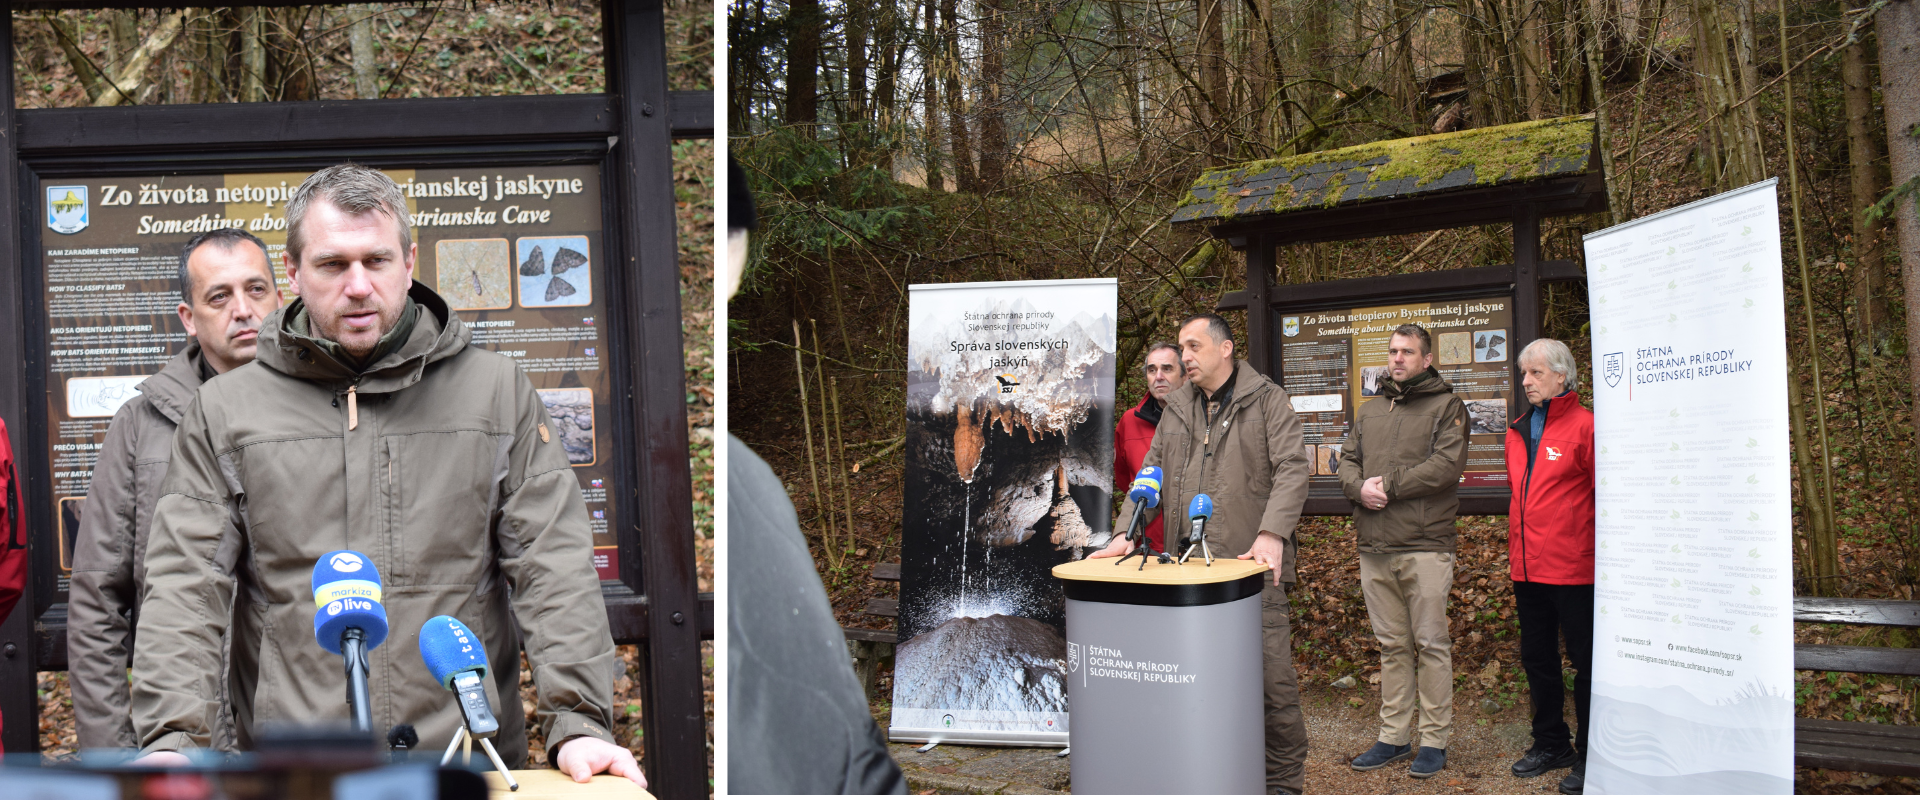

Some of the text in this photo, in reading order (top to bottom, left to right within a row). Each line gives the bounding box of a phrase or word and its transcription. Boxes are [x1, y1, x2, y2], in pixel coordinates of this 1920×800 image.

[100, 174, 583, 208] Zo života netopie rianskej jaskyne
[137, 205, 550, 234] Something abo strianska Cave
[48, 249, 63, 257] KAM
[100, 247, 139, 256] NETOPIERE?
[49, 283, 126, 293] HOW TO CLASSIFY BATS?
[964, 311, 990, 321] Štátna
[991, 310, 1024, 320] ochrana
[1303, 315, 1316, 325] Zo
[1318, 314, 1345, 324] života
[1348, 311, 1398, 323] netopierov
[1400, 304, 1462, 320] Bystrianskej
[1464, 302, 1504, 317] jaskyne
[50, 327, 65, 335] AKO
[66, 326, 74, 334] SA
[114, 324, 152, 332] NETOPIERE?
[477, 320, 515, 328] NETOPIERE?
[968, 321, 1050, 334] Slovenskej republiky
[1317, 327, 1360, 337] Something
[1361, 324, 1386, 334] about
[1386, 322, 1400, 331] bat
[1467, 316, 1490, 326] Cave
[51, 349, 67, 357] HOW
[68, 348, 84, 356] BATS
[85, 347, 119, 356] ORIENTATE
[120, 346, 160, 355] THEMSELVES
[951, 338, 1069, 355] Správa slovenských
[1636, 346, 1673, 360] ŠTÁTNA
[989, 355, 1029, 371] jaskýň
[1636, 348, 1734, 372] OCHRANA PRÍRODY
[1636, 359, 1752, 385] SLOVENSKEJ REPUBLIKY
[53, 443, 75, 452] PREČO
[76, 442, 94, 451] VISIA
[54, 470, 69, 479] WHY
[70, 469, 86, 478] BATS
[344, 598, 373, 612] live
[1089, 644, 1122, 658] ŠTÁTNA
[1089, 656, 1179, 673] OCHRANA PRÍRODY
[1089, 667, 1197, 684] SLOVENSKEJ REPUBLIKY
